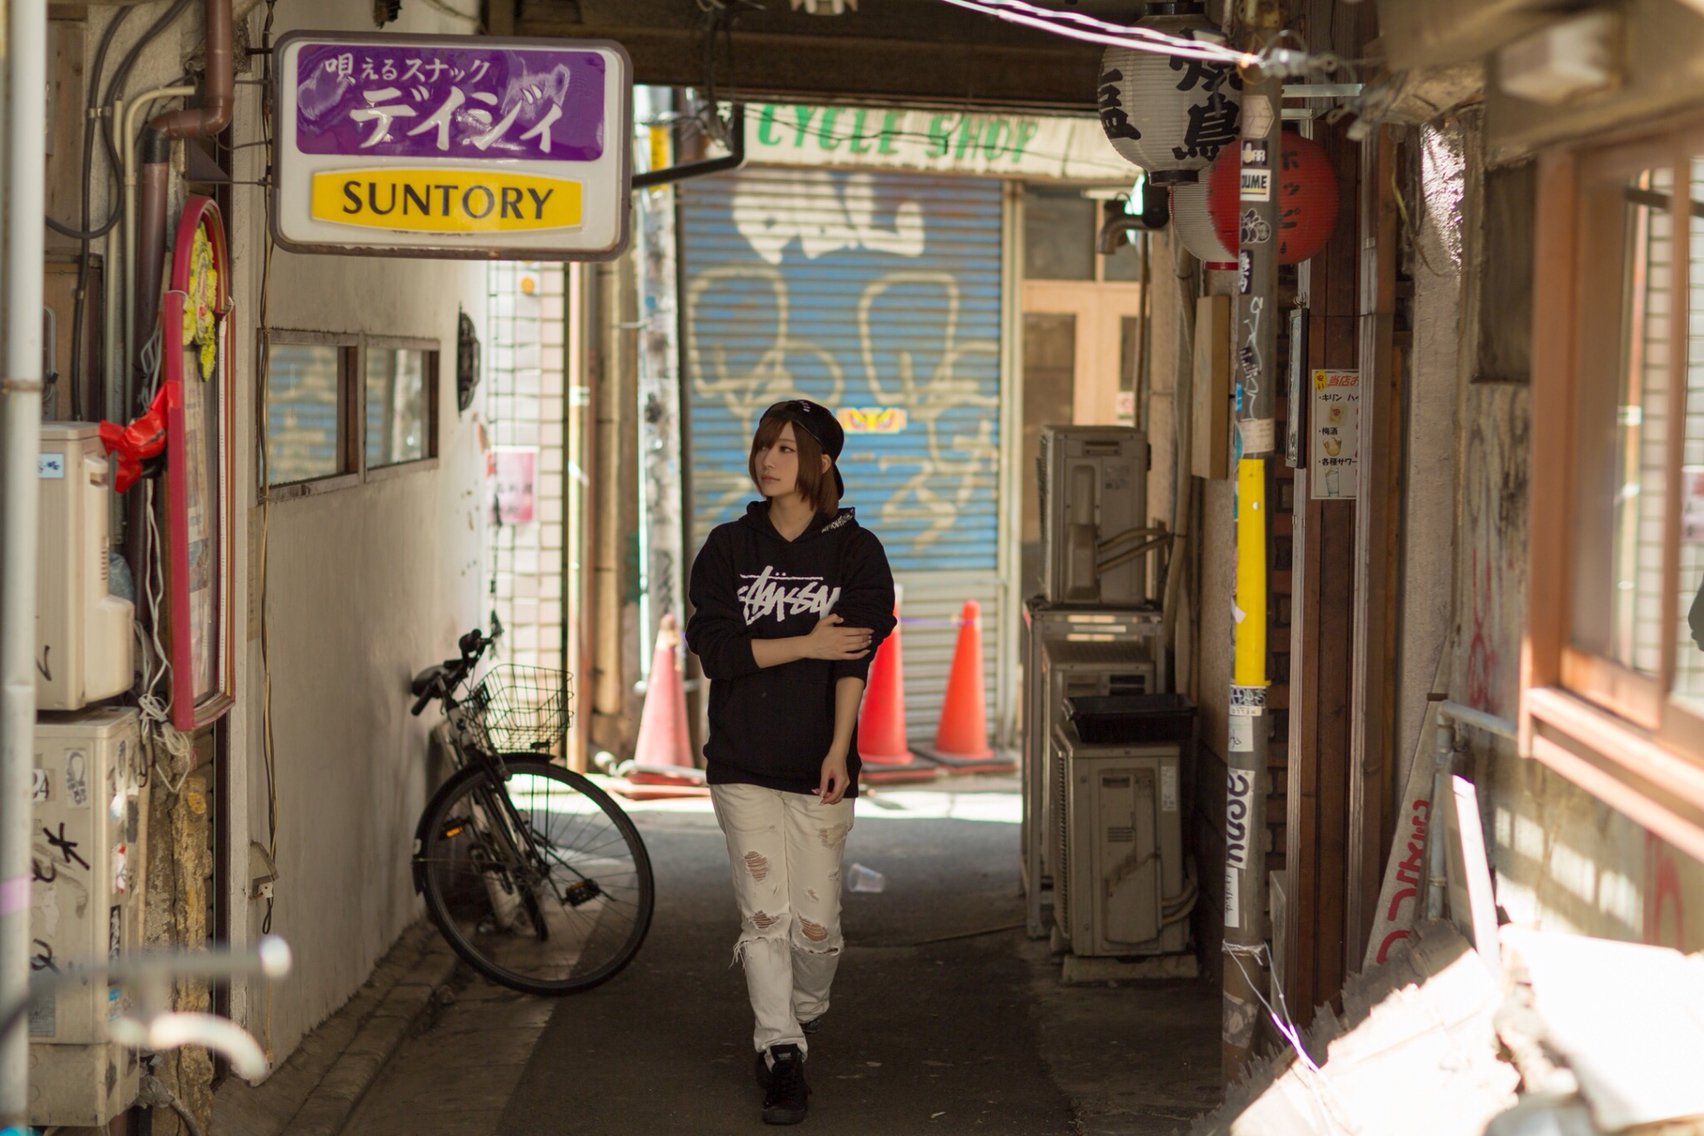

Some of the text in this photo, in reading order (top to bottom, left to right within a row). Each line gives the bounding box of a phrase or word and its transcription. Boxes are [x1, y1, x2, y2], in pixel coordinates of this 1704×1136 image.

[324, 52, 490, 85] 唄えるスナック
[757, 103, 1038, 163] CYCLE SHOP
[342, 180, 554, 219] SUNTORY
